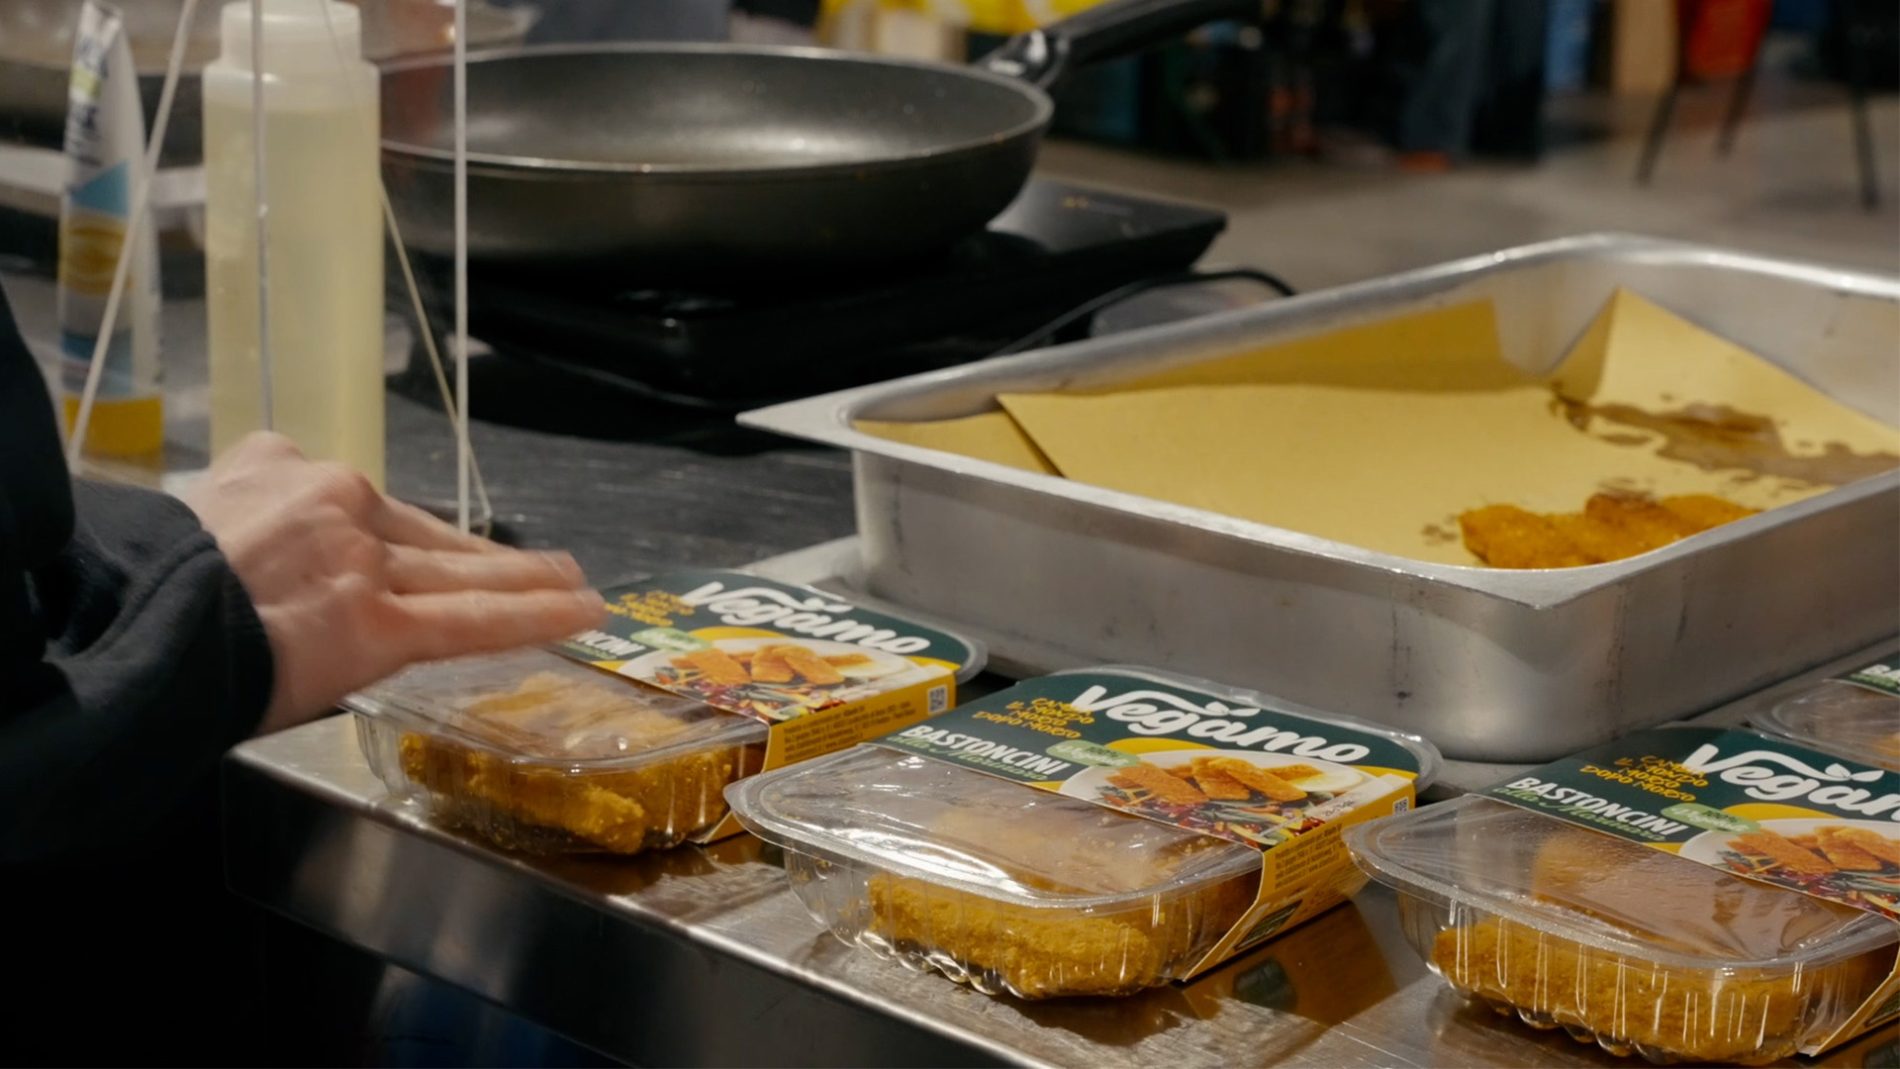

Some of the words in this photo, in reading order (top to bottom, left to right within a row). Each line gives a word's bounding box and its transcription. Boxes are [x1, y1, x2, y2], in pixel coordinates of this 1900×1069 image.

[680, 581, 931, 655] Vegamo
[898, 724, 1072, 776] BASTONCINI
[1071, 685, 1370, 763] Vegamo
[1505, 776, 1689, 836] BASTONCINI
[1579, 764, 1633, 784] DOPO
[1632, 780, 1697, 802] MORSO
